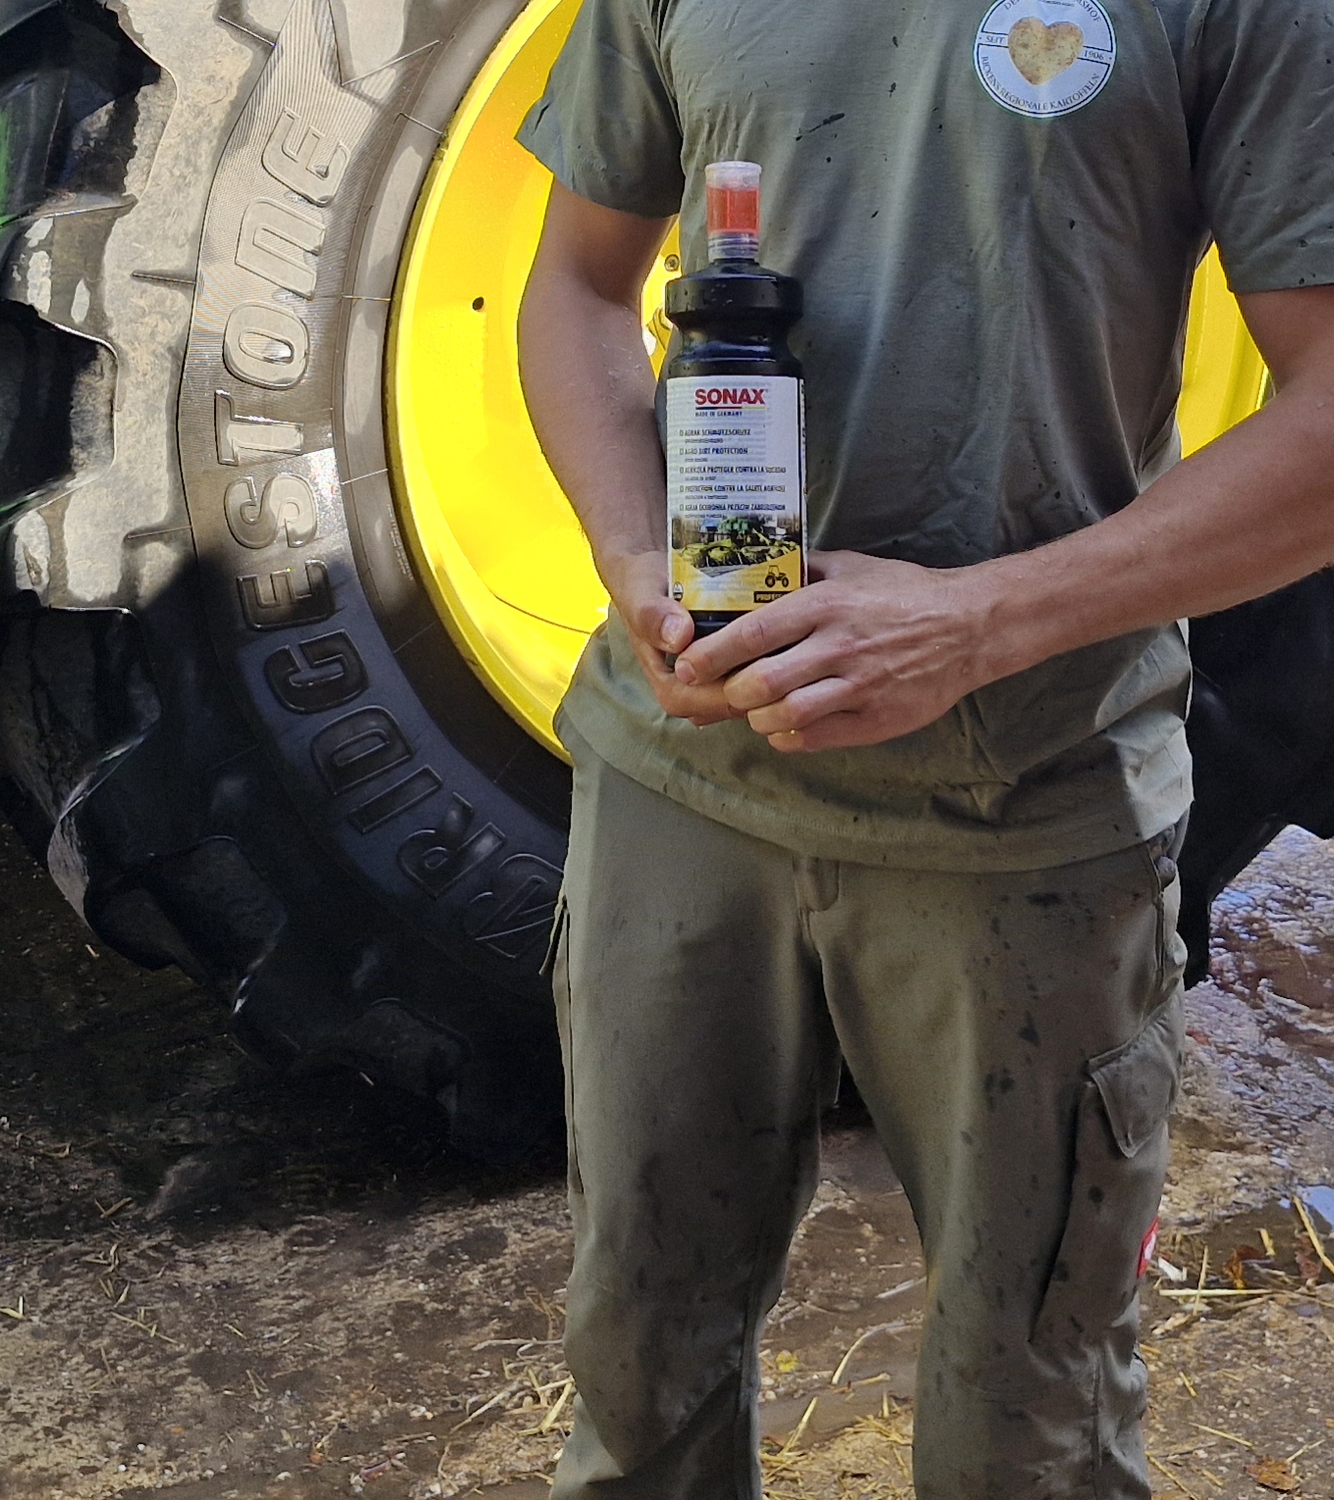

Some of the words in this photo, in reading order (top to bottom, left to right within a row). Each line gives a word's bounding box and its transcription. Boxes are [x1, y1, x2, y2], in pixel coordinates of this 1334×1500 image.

[986, 35, 1005, 45] SEIT
[1084, 50, 1105, 61] 1906
[1000, 86, 1048, 111] REGIONALE
[1049, 73, 1101, 110] KARTOFFELN
[694, 387, 766, 406] SONAX
[712, 447, 749, 455] PROTECTION
[212, 105, 565, 961] BRIDGESTONE
